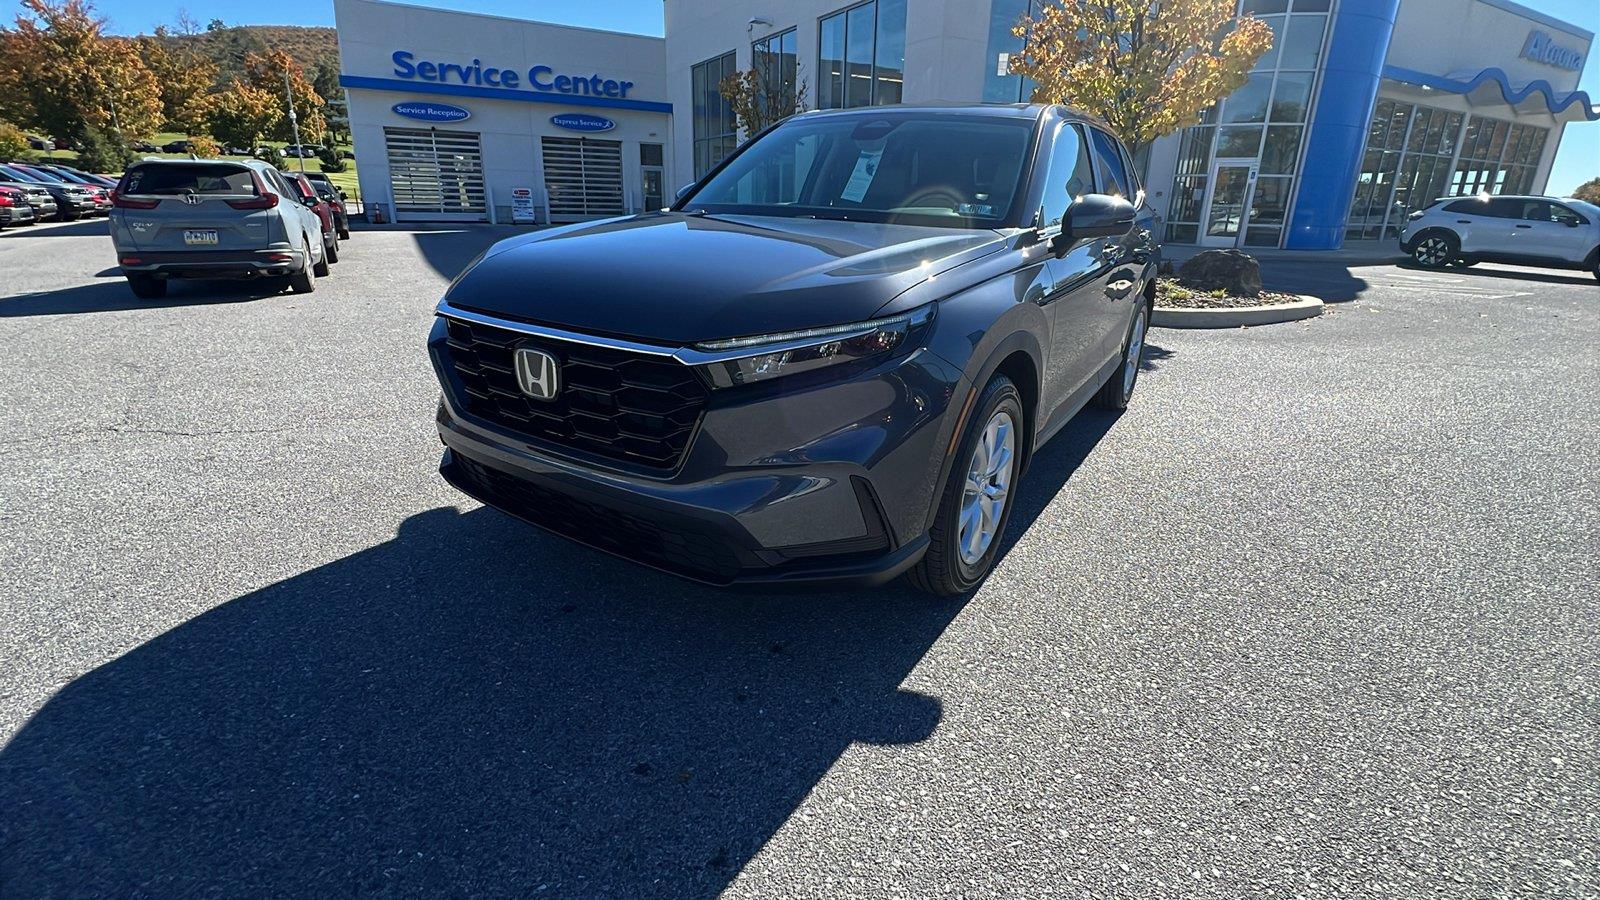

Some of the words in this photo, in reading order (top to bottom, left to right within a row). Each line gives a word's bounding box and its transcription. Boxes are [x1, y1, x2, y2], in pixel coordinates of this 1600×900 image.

[392, 51, 519, 87] Service
[529, 65, 634, 98] Center
[396, 105, 426, 115] Service
[427, 108, 466, 118] Reception
[553, 117, 578, 126] Express
